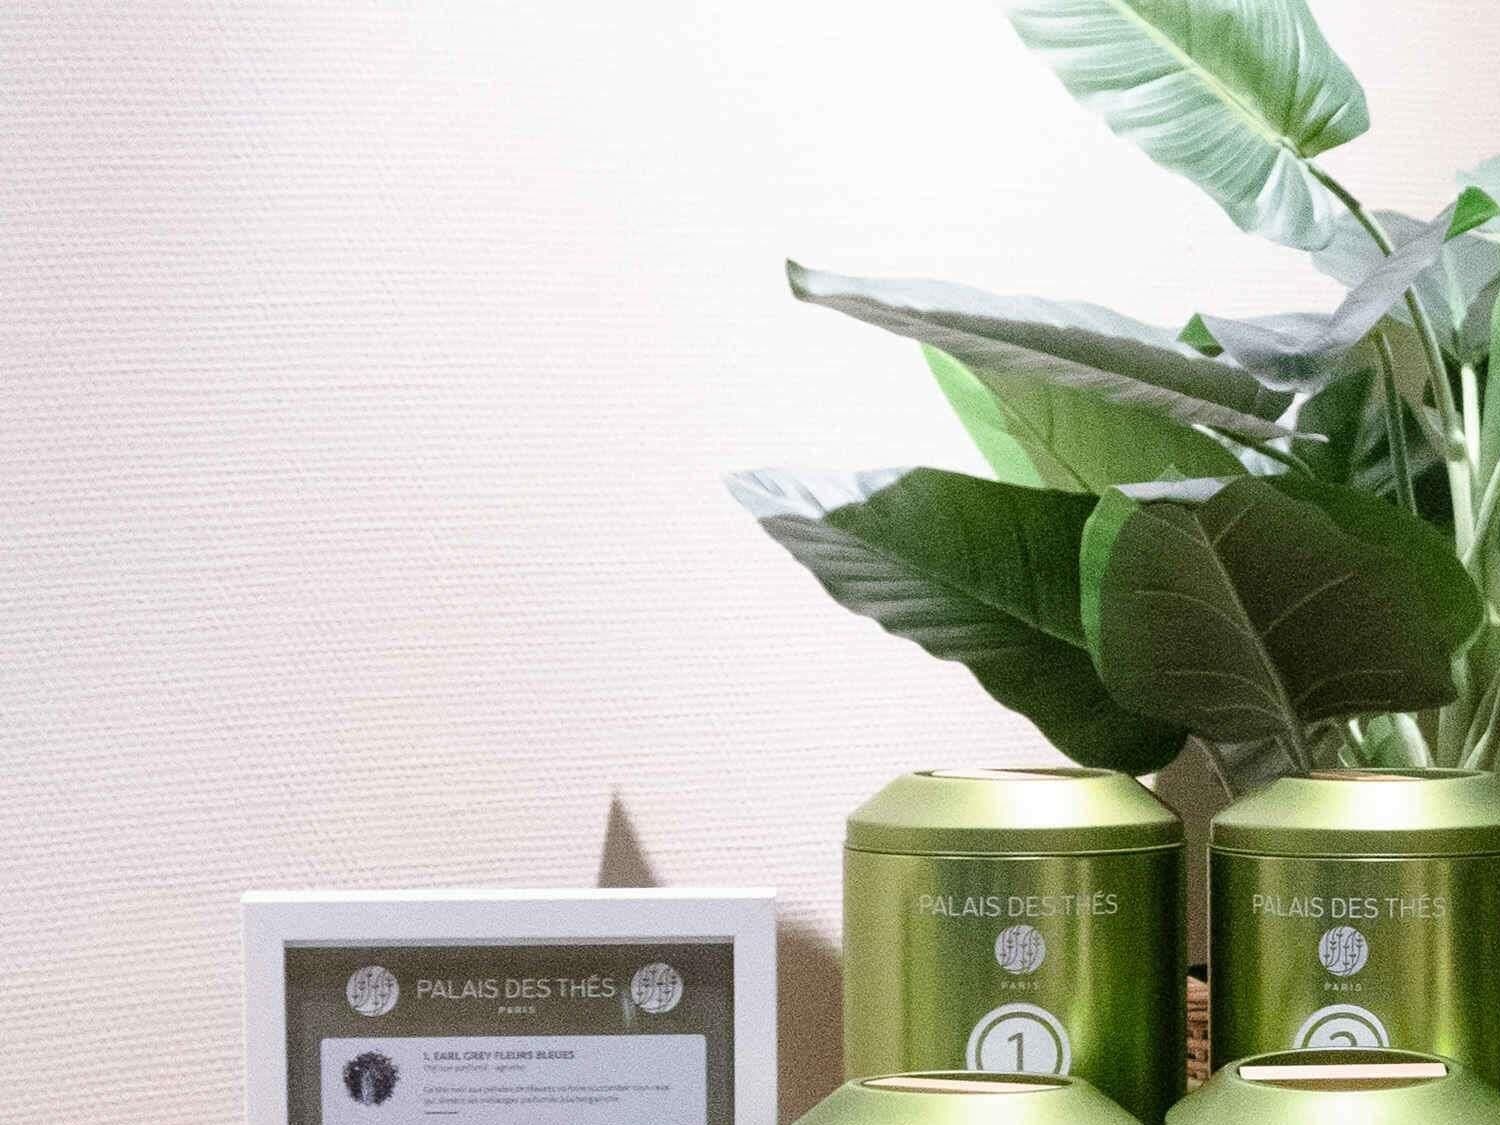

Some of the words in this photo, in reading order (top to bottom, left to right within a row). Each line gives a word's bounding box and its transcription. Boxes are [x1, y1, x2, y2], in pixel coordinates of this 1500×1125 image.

[918, 894, 1001, 918] PALAIS
[1008, 895, 1057, 918] DES
[1060, 890, 1119, 916] THÉS
[1252, 895, 1325, 919] PALAIS
[1331, 897, 1379, 920] DES
[1384, 893, 1447, 919] THÉS
[417, 978, 500, 999] PALAIS
[505, 978, 551, 999] DES
[557, 974, 616, 998] THÉS
[1324, 982, 1362, 992] PARIS
[1007, 1032, 1025, 1073] 1
